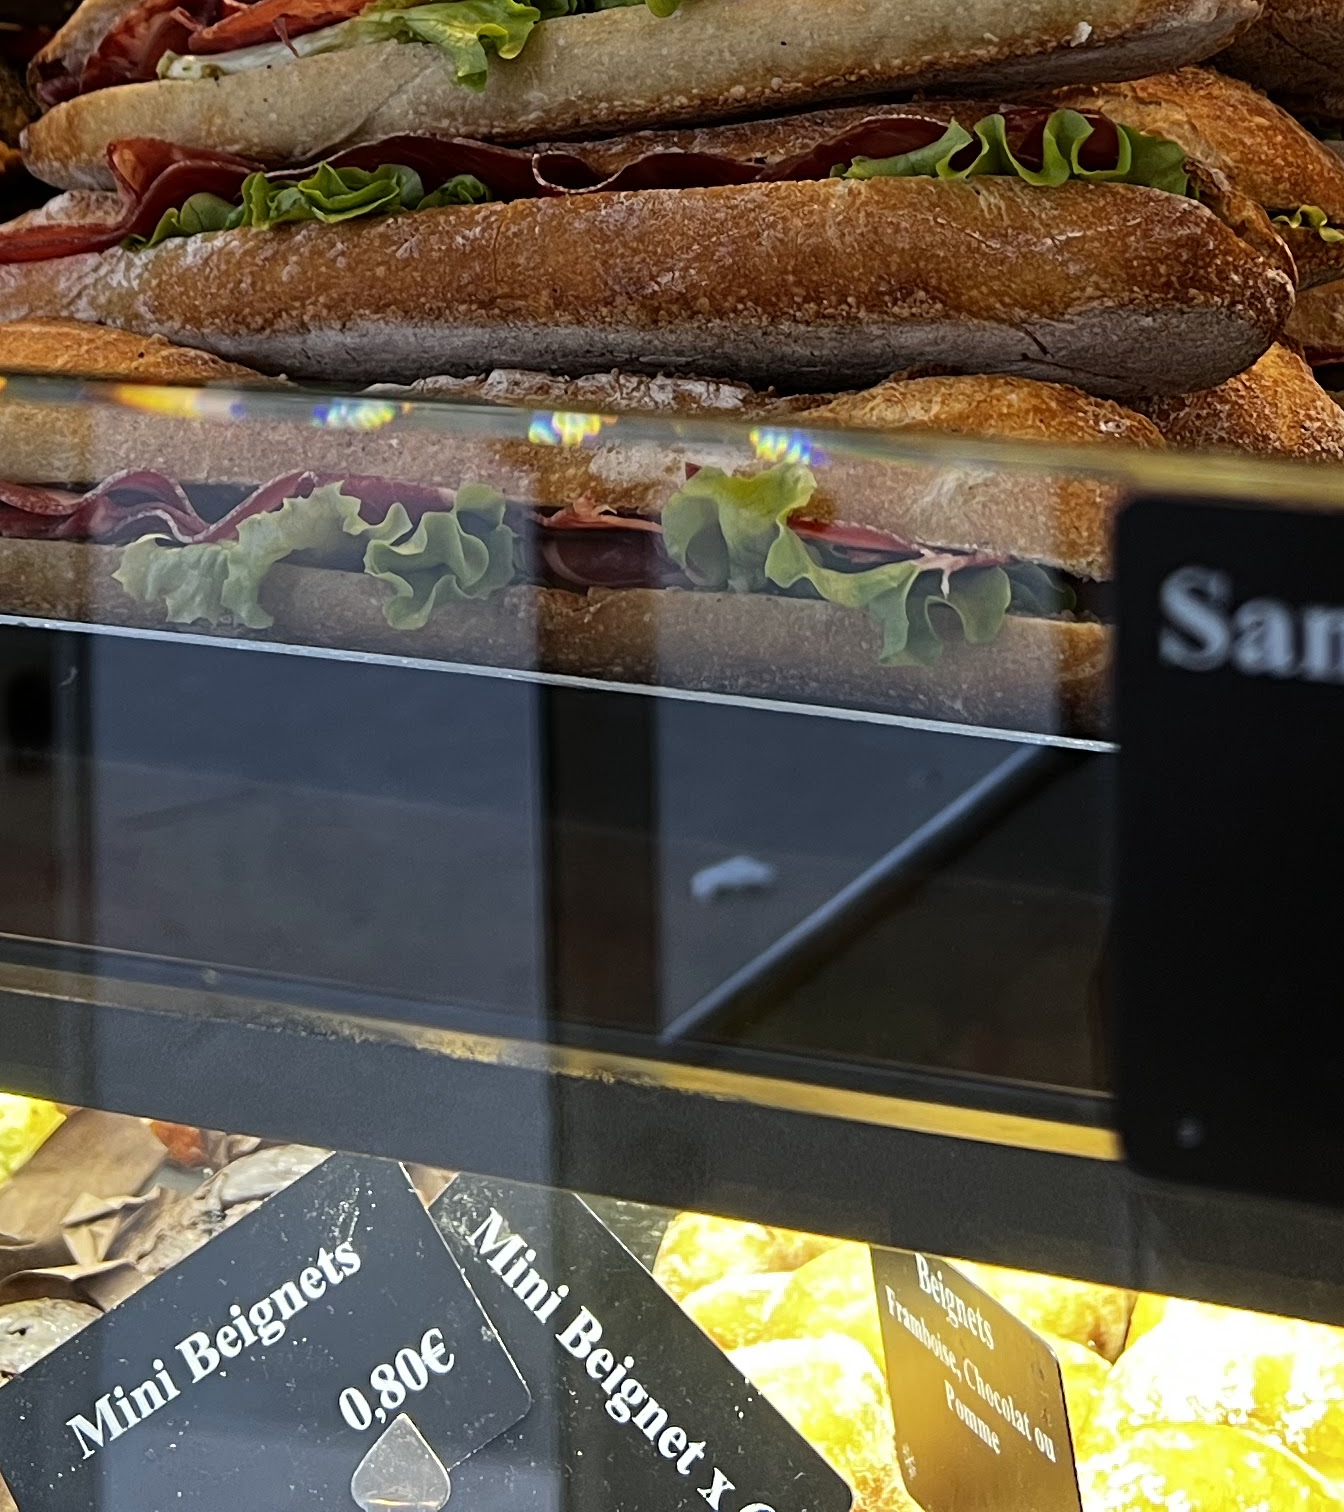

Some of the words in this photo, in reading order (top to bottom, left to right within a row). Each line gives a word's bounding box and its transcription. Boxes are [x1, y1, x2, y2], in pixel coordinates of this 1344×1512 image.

[65, 1355, 187, 1460] Mini
[174, 1239, 363, 1384] Beignets
[464, 1206, 569, 1326] Mini
[554, 1304, 707, 1476] Beignet
[696, 1467, 736, 1511] x
[914, 1251, 996, 1351] Beignets
[337, 1326, 457, 1434] 0,80€
[884, 1284, 963, 1383] Framboise,
[963, 1357, 1033, 1442] Chocolat
[1034, 1426, 1056, 1464] ou
[944, 1380, 1001, 1455] Pomme
